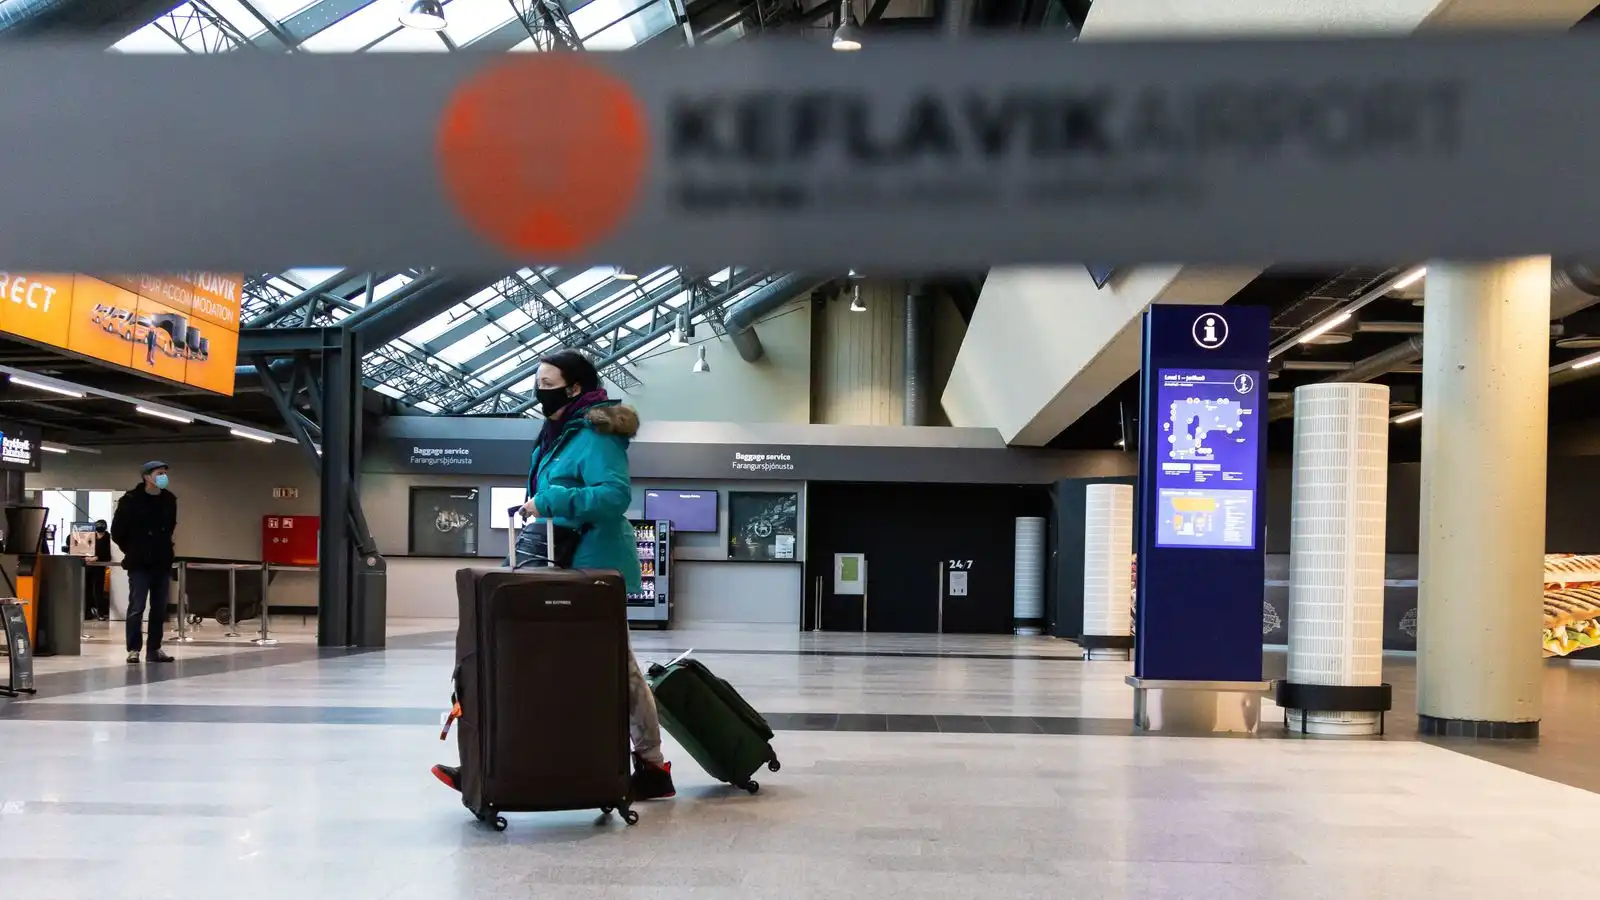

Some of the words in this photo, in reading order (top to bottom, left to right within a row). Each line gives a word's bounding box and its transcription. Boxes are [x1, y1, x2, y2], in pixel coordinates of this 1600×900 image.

[413, 446, 443, 456] Baggage
[735, 452, 765, 462] Baggage
[766, 453, 791, 461] service
